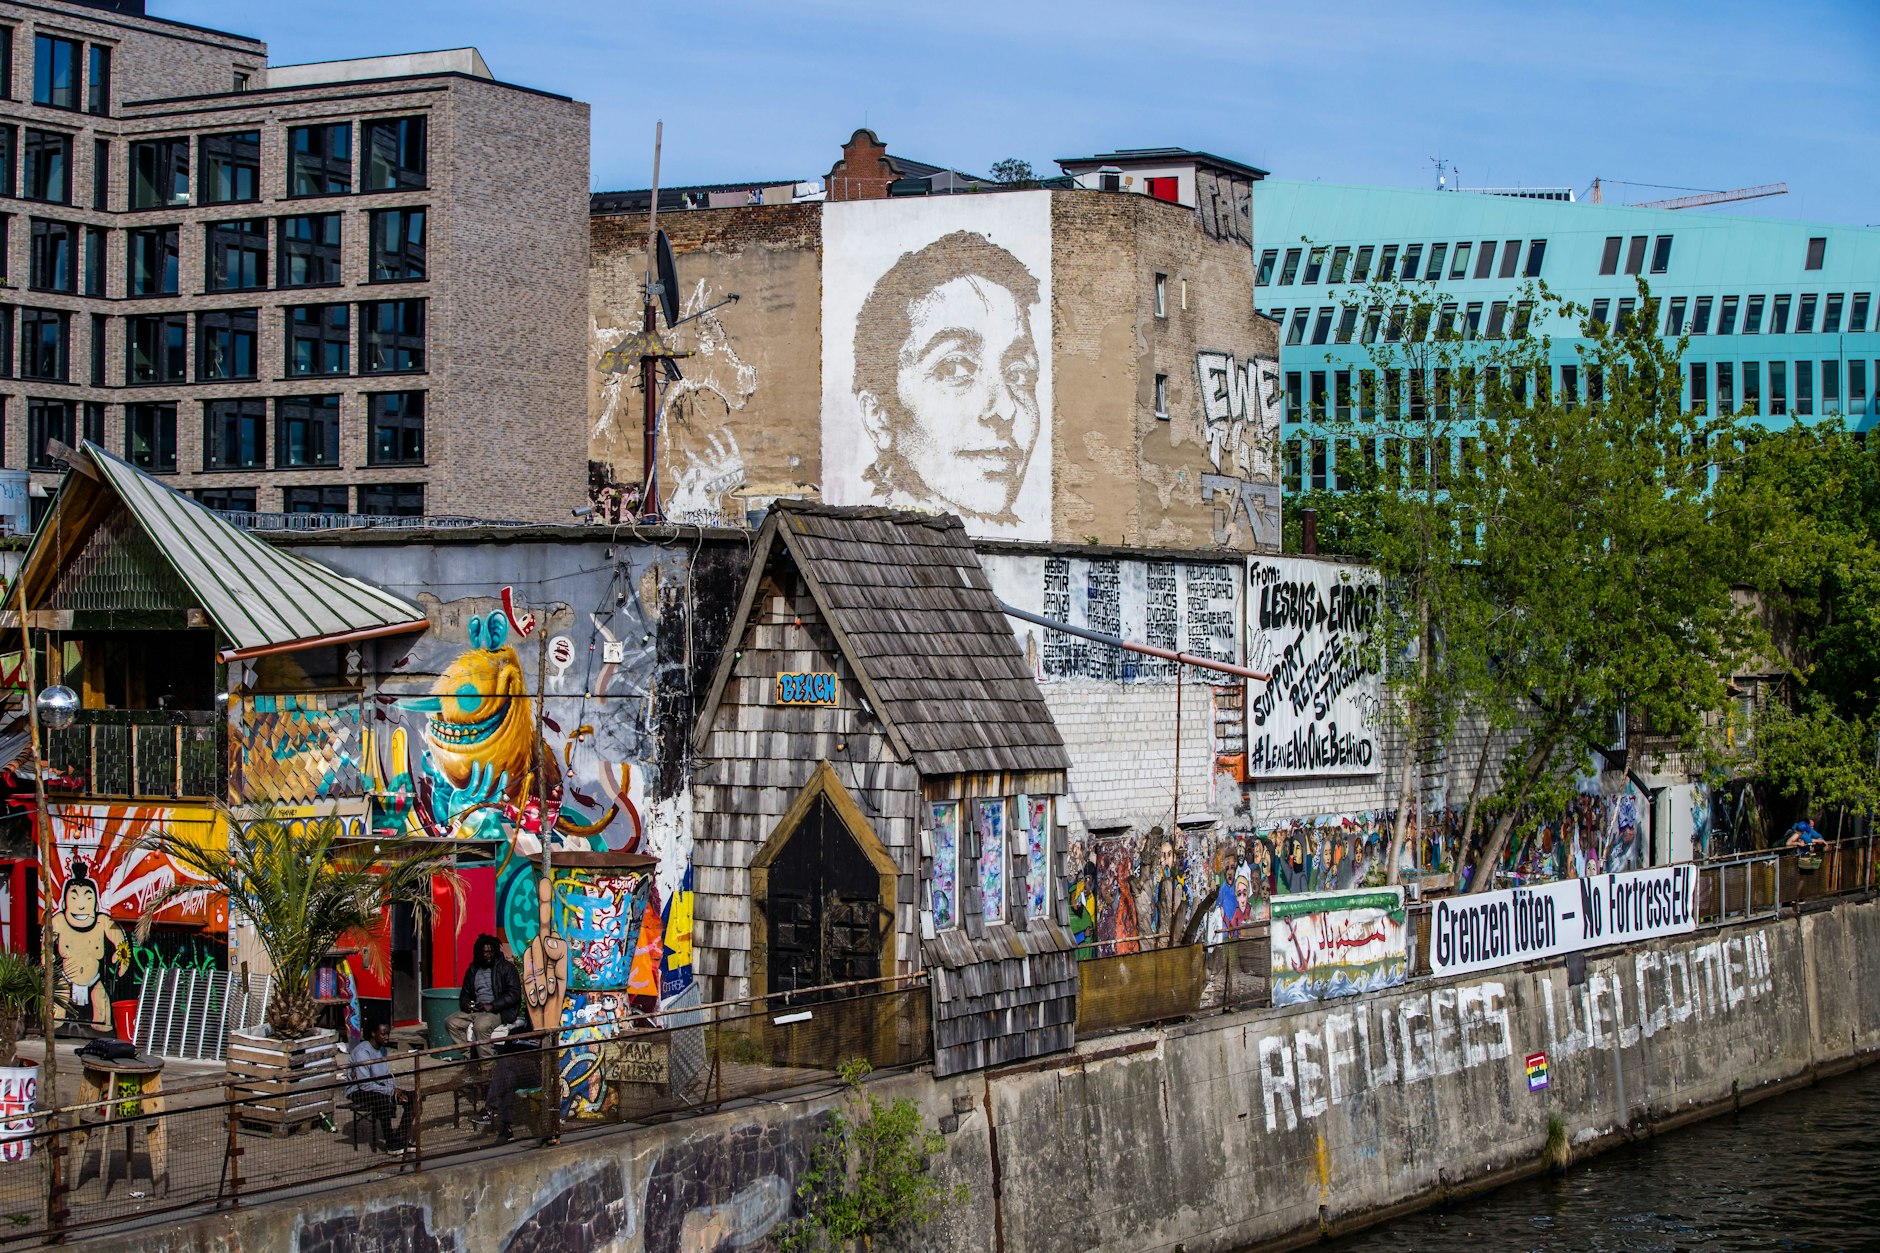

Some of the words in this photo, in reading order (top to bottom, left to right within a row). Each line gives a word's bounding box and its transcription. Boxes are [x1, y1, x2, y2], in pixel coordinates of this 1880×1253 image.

[1044, 575, 1069, 593] SAMIR
[1251, 561, 1280, 587] From:
[1044, 592, 1060, 610] IRAN
[1260, 580, 1316, 632] LESBOS
[780, 673, 836, 704] BEACH
[1253, 629, 1306, 727] SUPPORT
[1288, 632, 1343, 718] REFUGEE
[1436, 901, 1511, 967] Grenzen
[1513, 888, 1556, 951] töten
[1579, 877, 1602, 939] No
[1258, 981, 1513, 1135] REFUGEES
[1542, 929, 1772, 1062] WELCOME!!!
